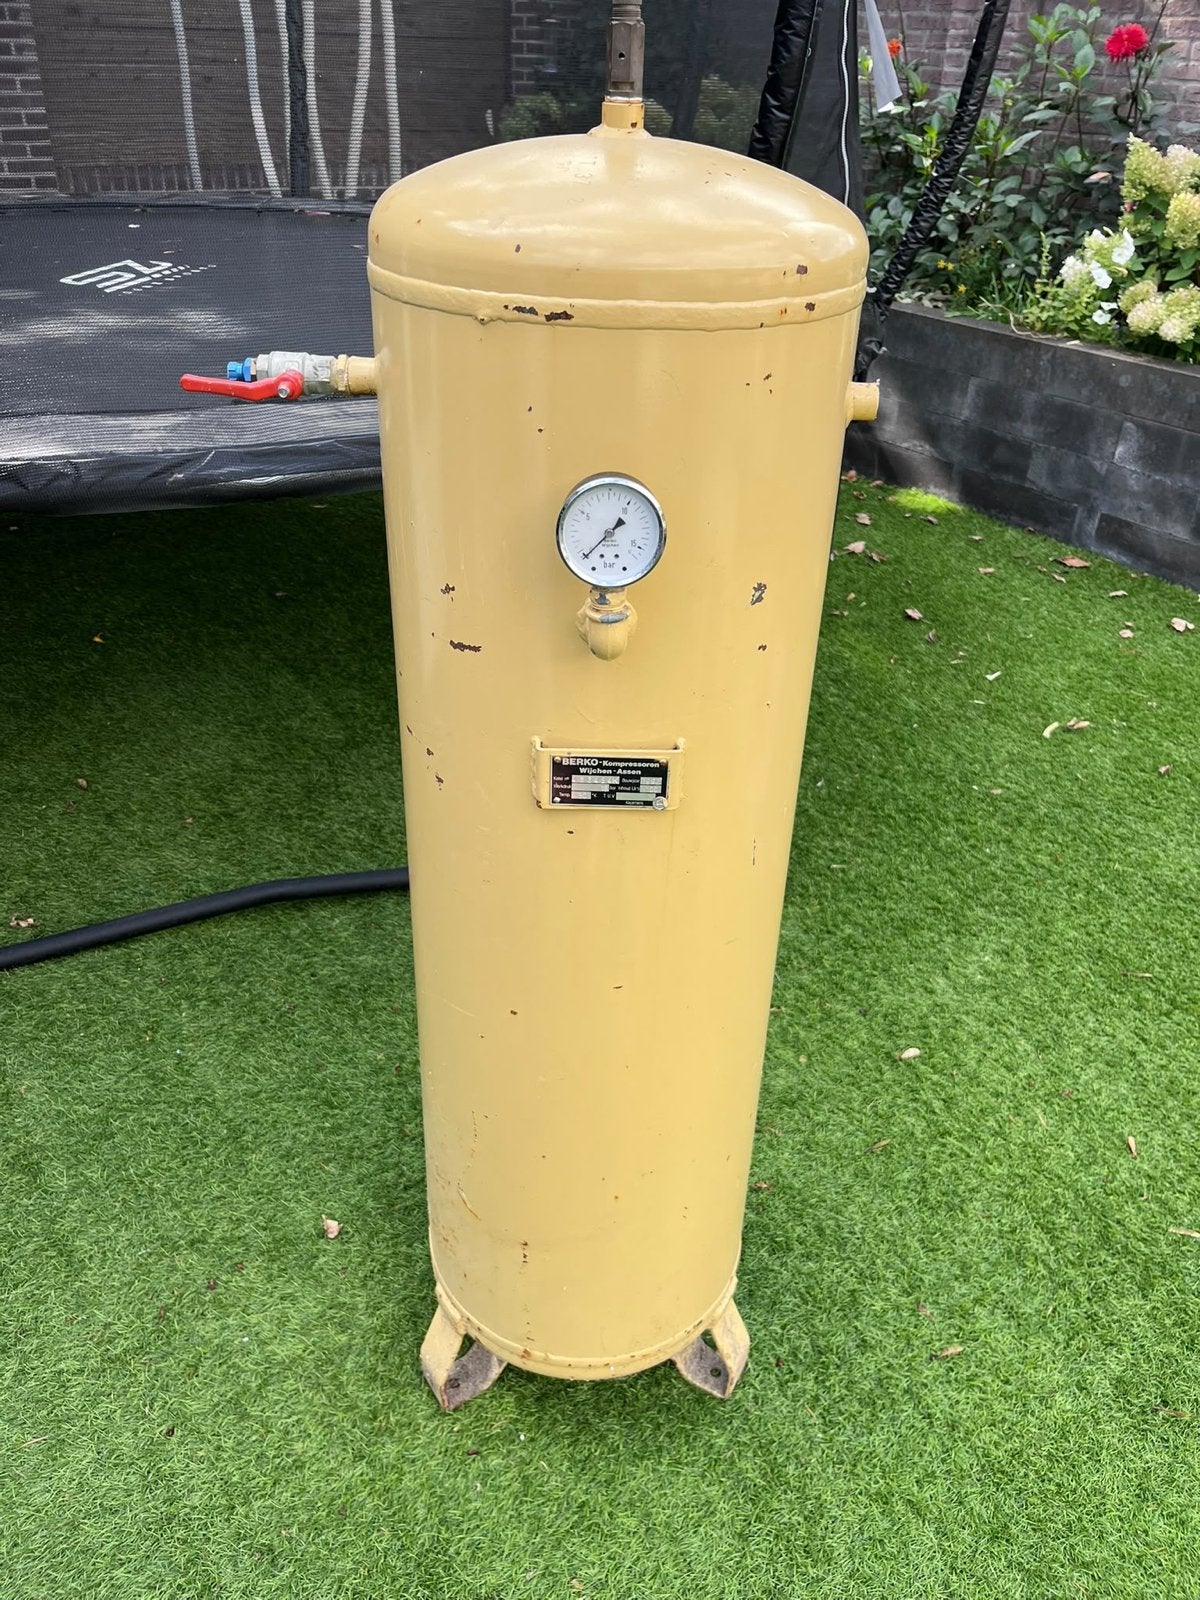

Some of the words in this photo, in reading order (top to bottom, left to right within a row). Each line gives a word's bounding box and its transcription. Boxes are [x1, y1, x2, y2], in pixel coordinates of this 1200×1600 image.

[621, 507, 628, 515] 10
[630, 539, 637, 548] 15
[603, 561, 616, 569] bar
